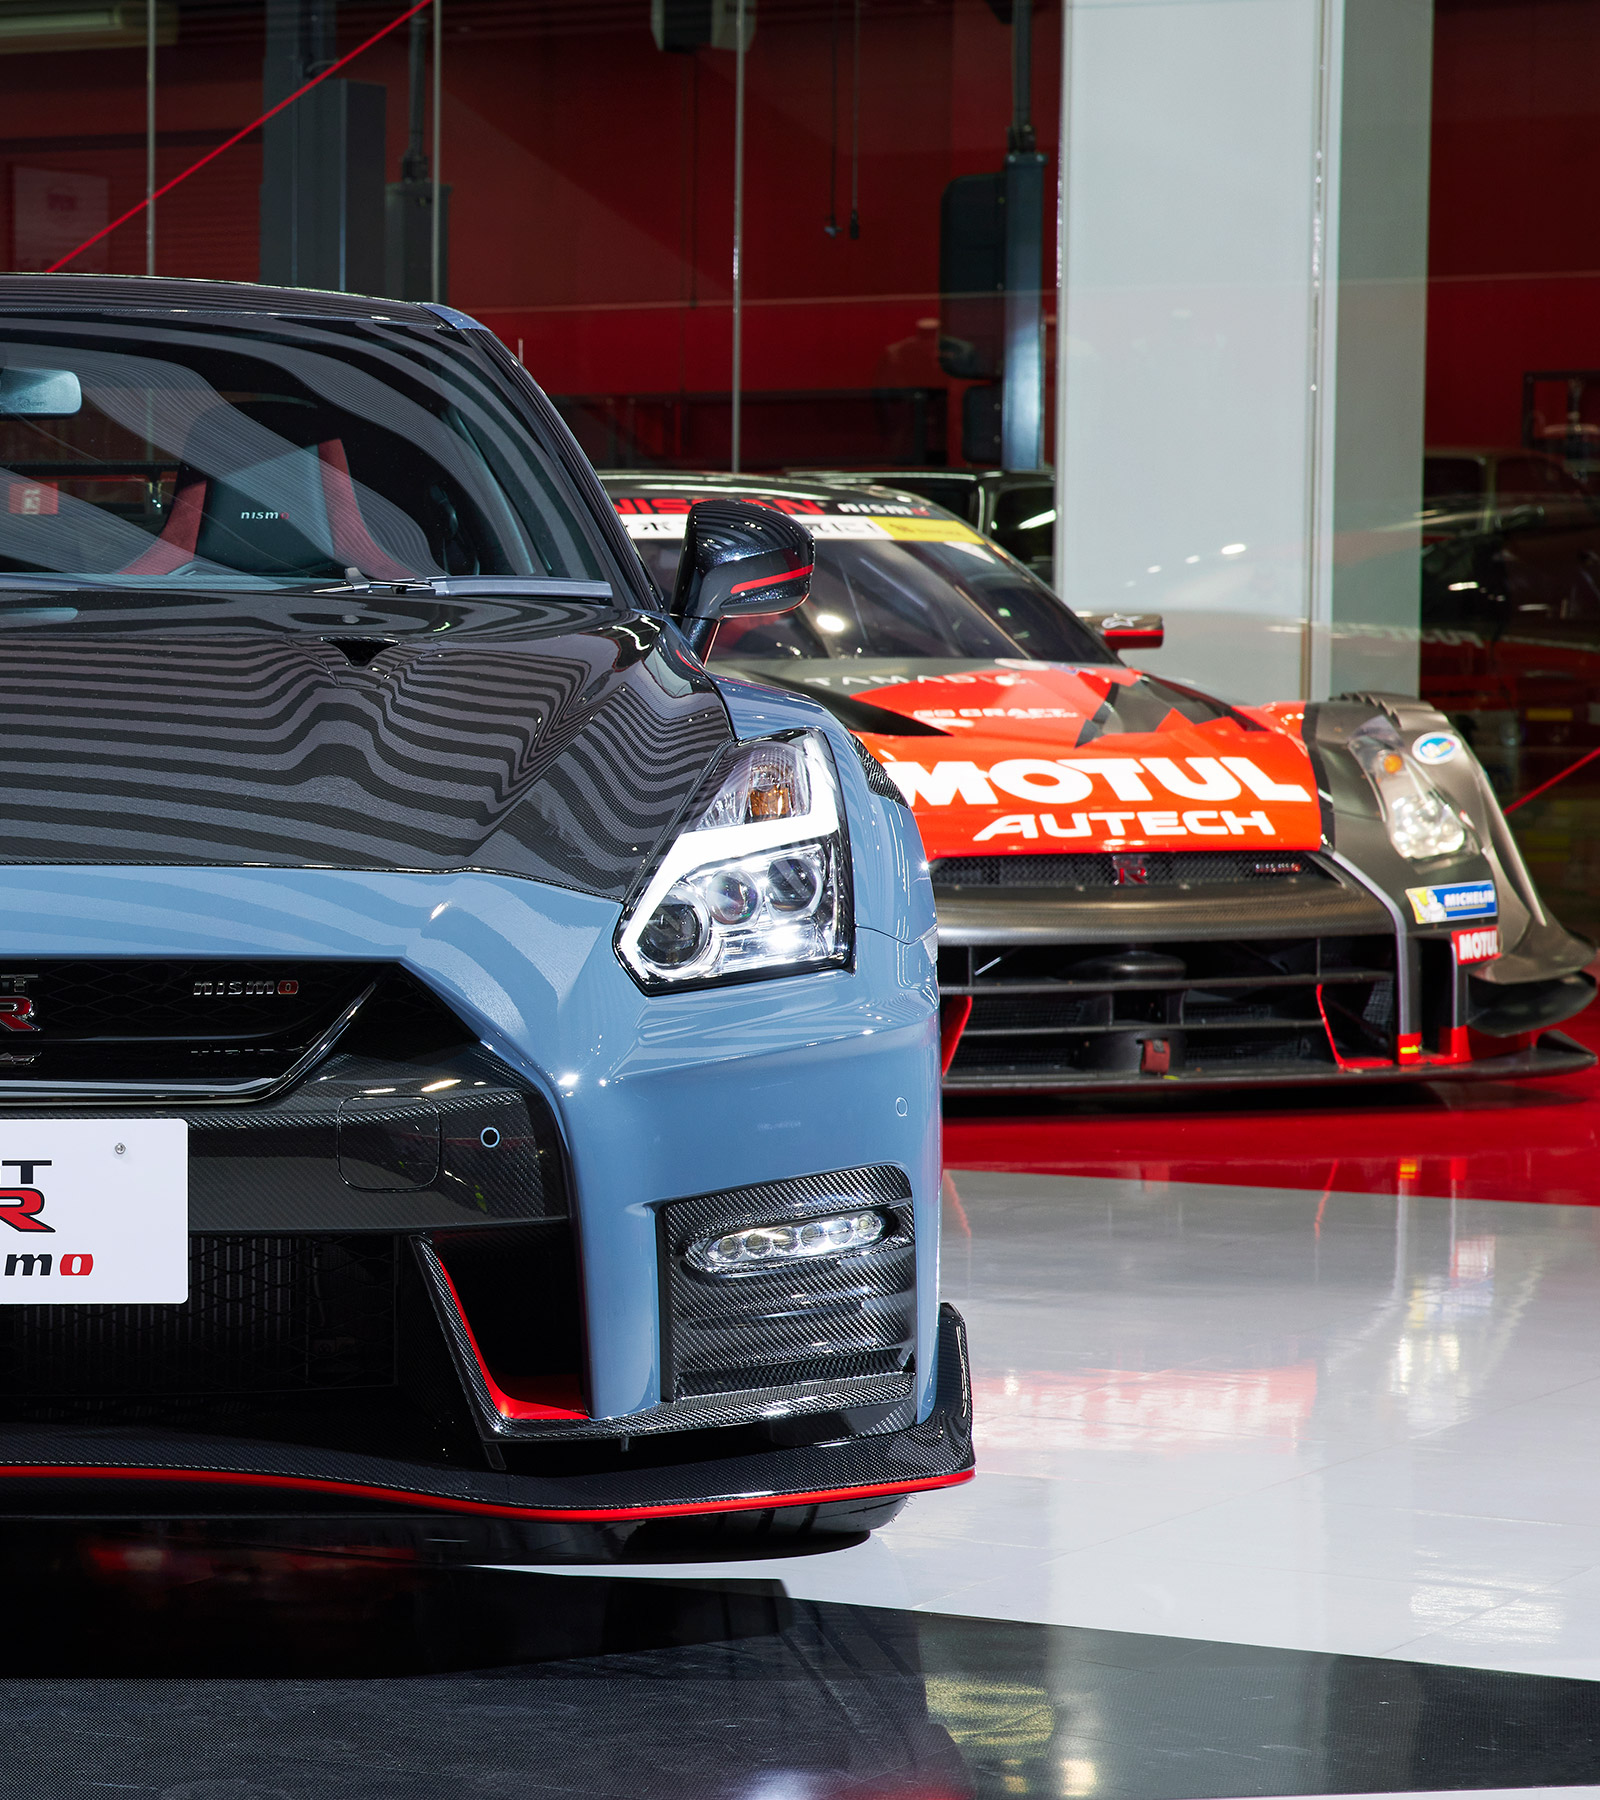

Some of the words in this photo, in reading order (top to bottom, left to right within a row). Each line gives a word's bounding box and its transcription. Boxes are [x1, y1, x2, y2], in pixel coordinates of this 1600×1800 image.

[241, 511, 289, 520] nismo
[884, 757, 1312, 805] MOTUL
[973, 810, 1276, 841] AUTECH
[1444, 890, 1495, 908] MICHELIN
[193, 980, 299, 995] nismo
